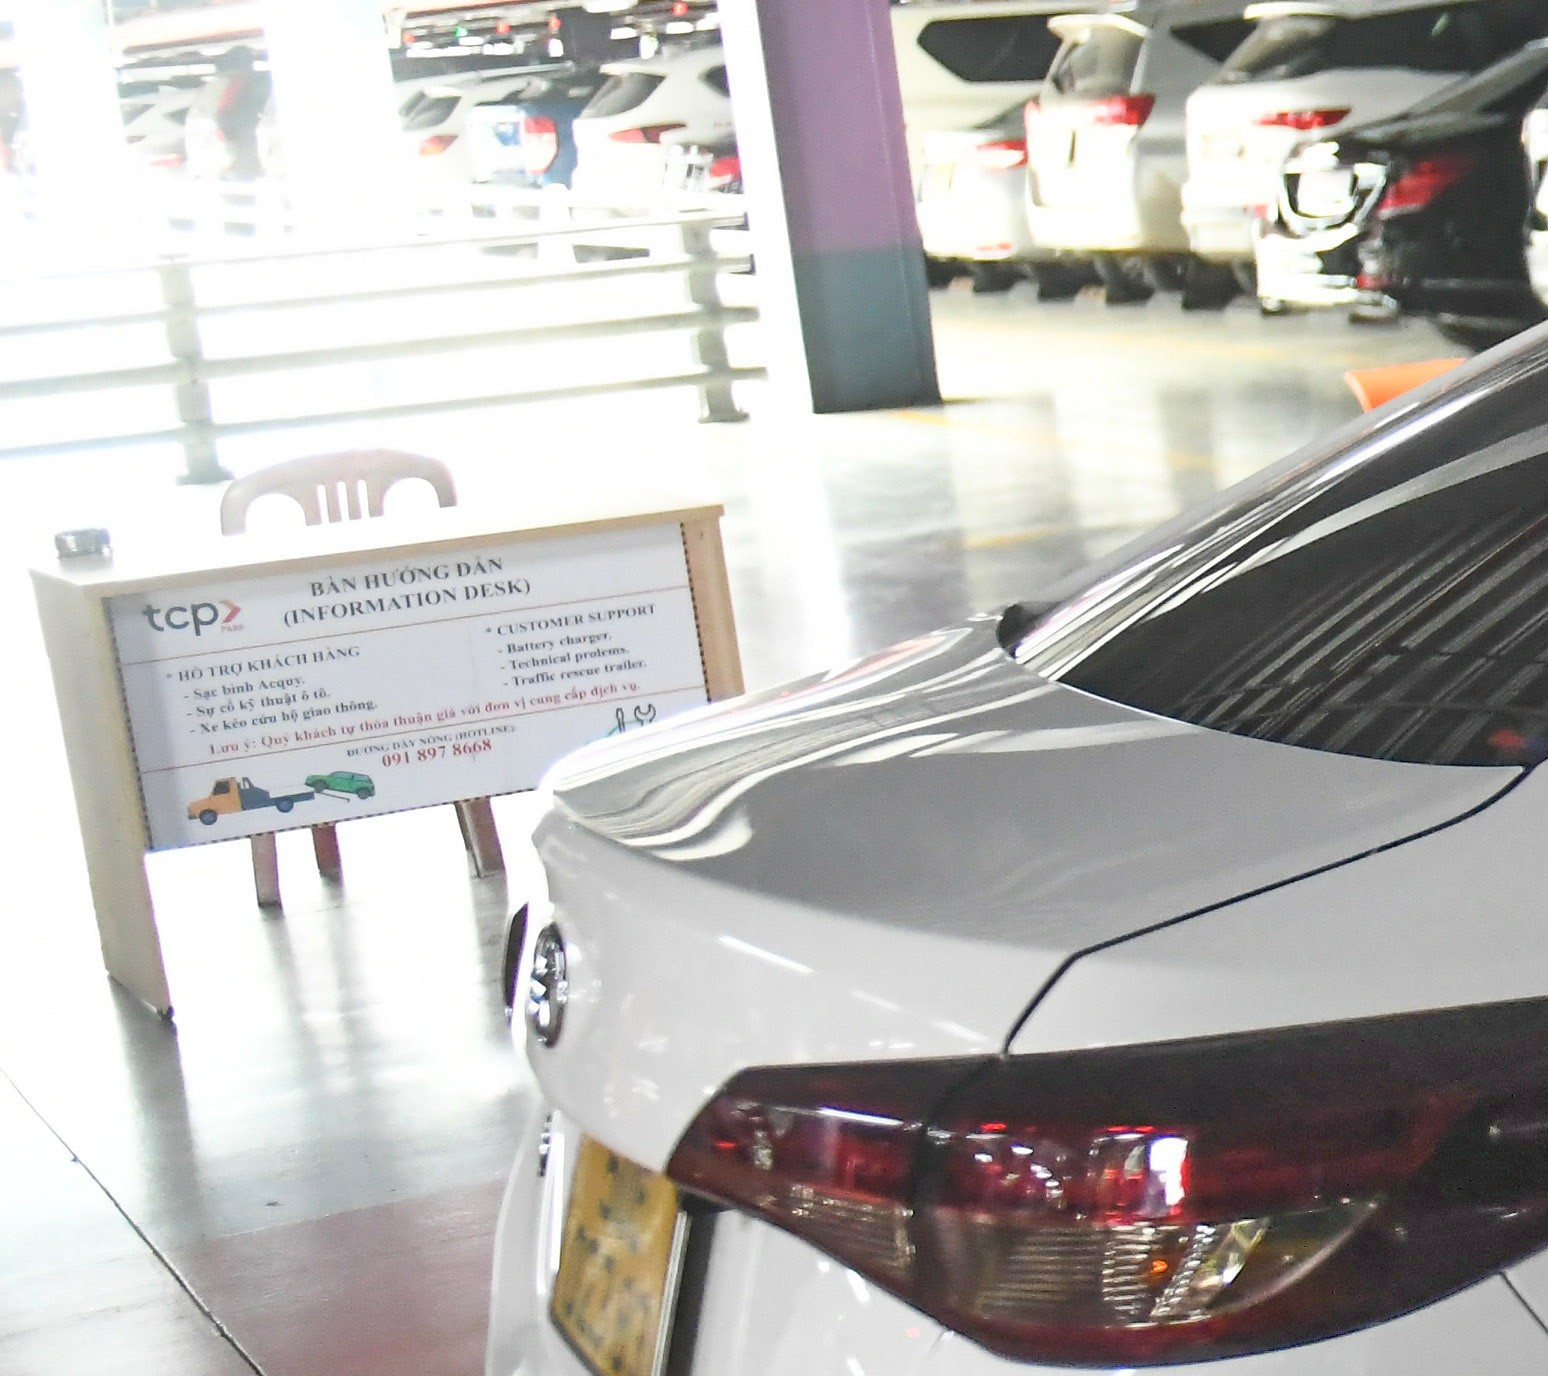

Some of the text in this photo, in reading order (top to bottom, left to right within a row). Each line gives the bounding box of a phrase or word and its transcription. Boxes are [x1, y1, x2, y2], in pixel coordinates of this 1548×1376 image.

[365, 564, 450, 590] HƯỚNG
[284, 578, 531, 627] (INFORMATION DESK)
[142, 602, 219, 636] tcp
[497, 604, 656, 636] CUSTOMER SUPPORT
[506, 632, 612, 655] Battery charger.
[210, 660, 243, 678] TRỢ
[248, 652, 308, 672] KHÁCH
[313, 646, 361, 666] HÀNG
[509, 653, 571, 670] Technical
[512, 659, 647, 687] Traffic rescue trailer.
[220, 699, 235, 713] cố
[261, 693, 296, 708] thuật
[295, 725, 337, 741] khách
[393, 713, 432, 727] thuận
[461, 705, 481, 716] với
[485, 700, 510, 713] đơn
[515, 697, 526, 710] vị
[530, 693, 561, 706] cung
[565, 686, 587, 701] cấp
[591, 683, 618, 697] dịch
[199, 723, 218, 734] Xe
[223, 717, 248, 730] kéo
[282, 709, 298, 723] hộ
[303, 706, 331, 720] giao
[382, 739, 492, 767] 091 897 8668
